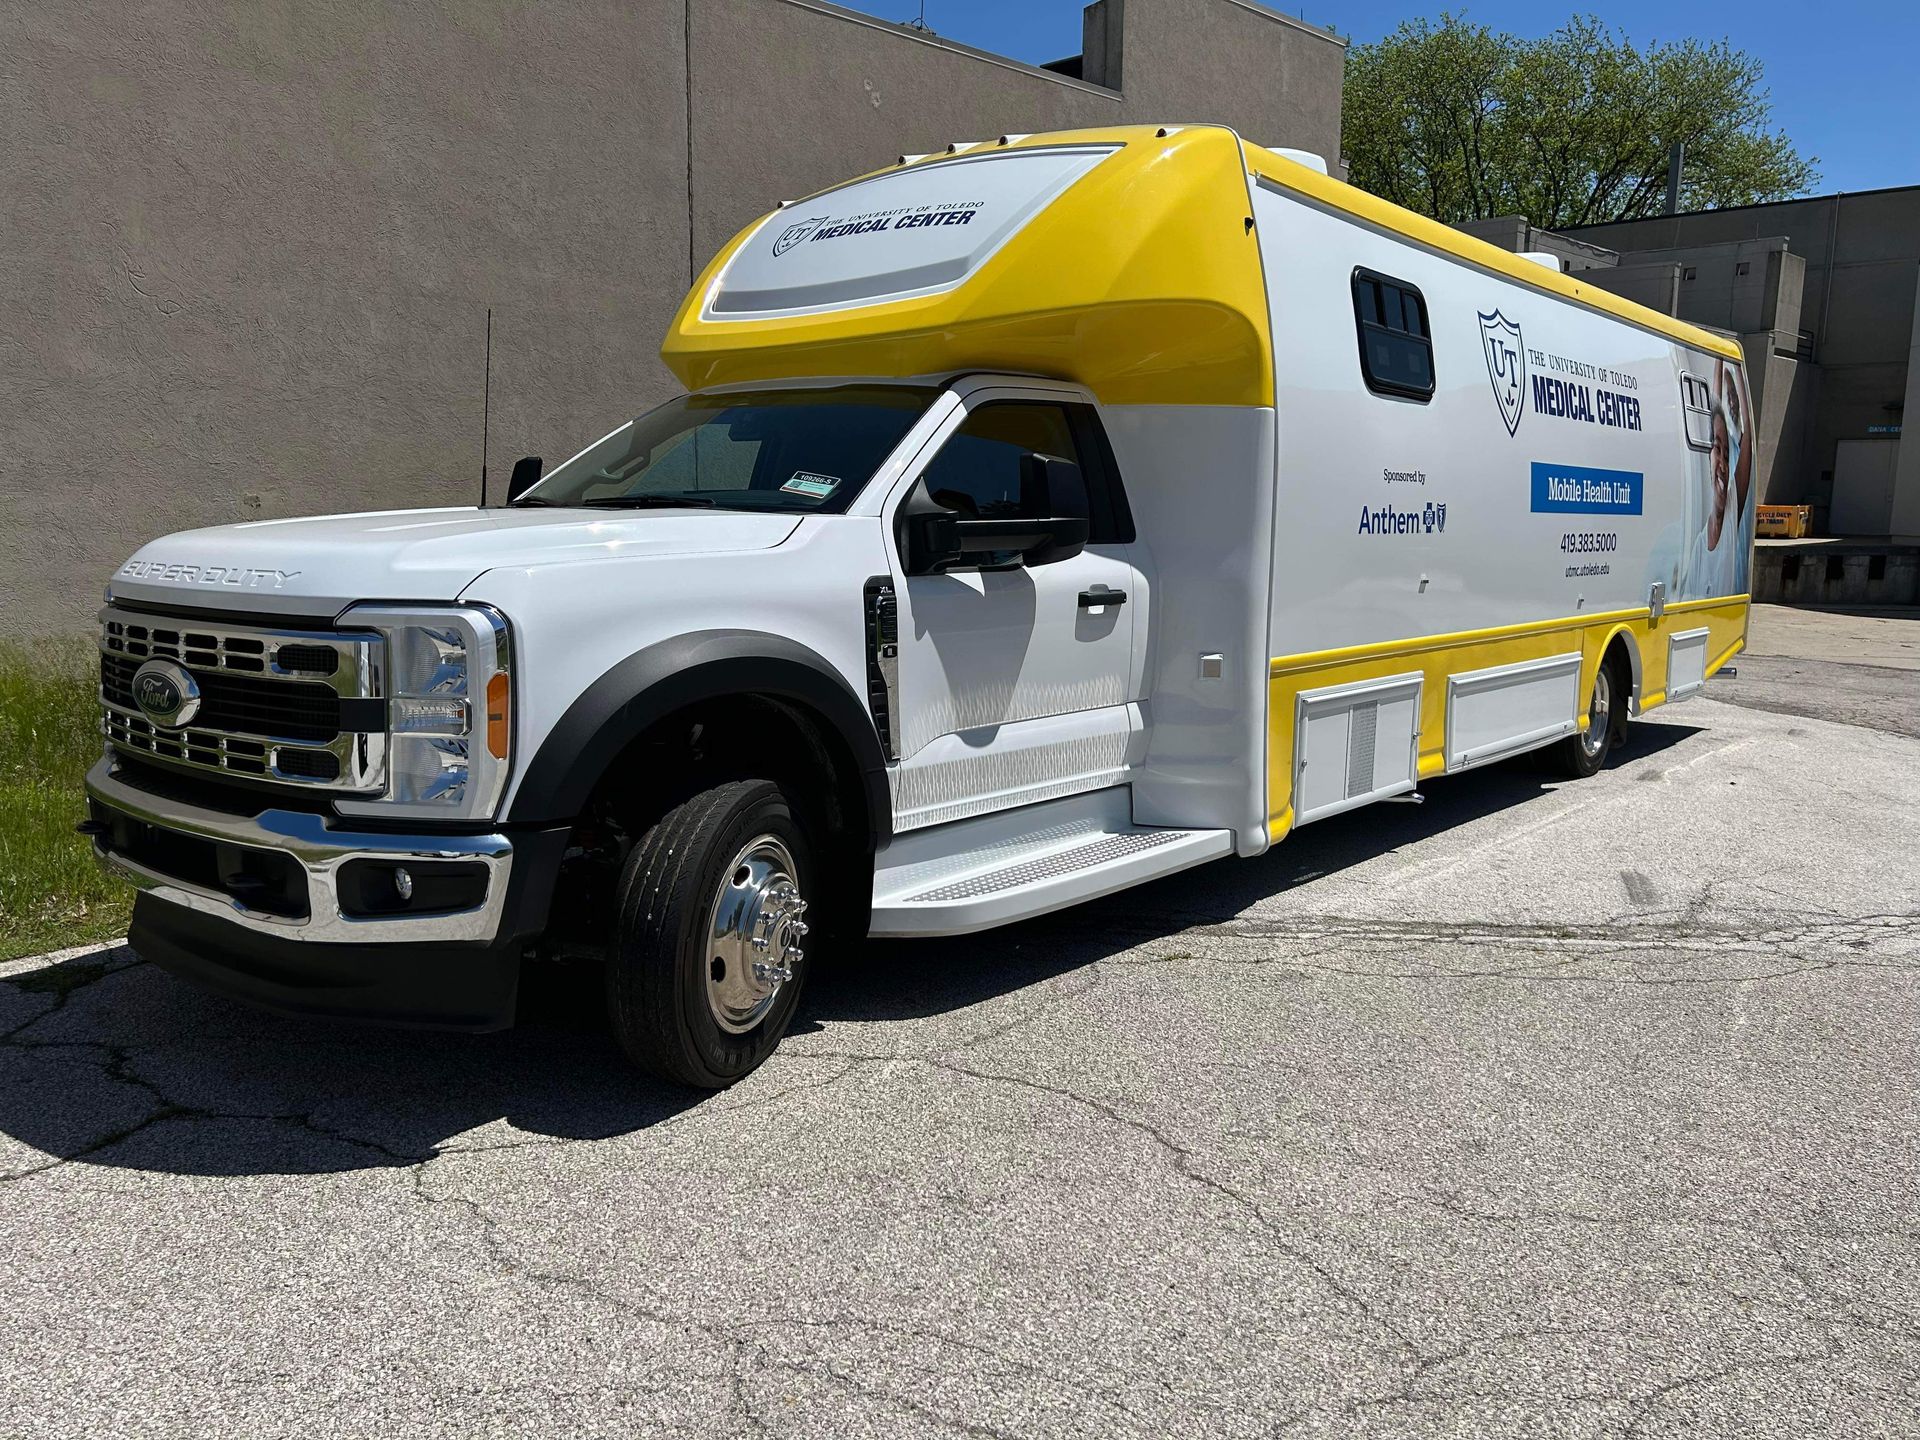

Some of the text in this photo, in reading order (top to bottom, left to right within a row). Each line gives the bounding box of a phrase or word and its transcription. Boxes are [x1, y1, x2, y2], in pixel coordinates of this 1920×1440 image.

[810, 210, 976, 242] MEDICAL CENTER
[825, 218, 844, 226] THE
[849, 207, 913, 222] UNIVERSITY
[937, 201, 985, 210] TOLEDO
[783, 227, 811, 241] UT
[1489, 337, 1517, 388] UT
[1528, 349, 1638, 391] THE UNIVERSITY OF TOLEDO
[1532, 374, 1642, 432] MEDICAL CENTER
[1383, 468, 1426, 485] Sponsored by
[1548, 477, 1631, 504] Mobile Health Unit
[1358, 504, 1420, 534] Anthem
[1560, 533, 1617, 553] 419.383.5000
[120, 560, 302, 588] SUPER DUTY
[1565, 562, 1610, 578] utmc.utoledo.edu
[141, 678, 170, 708] Ford
